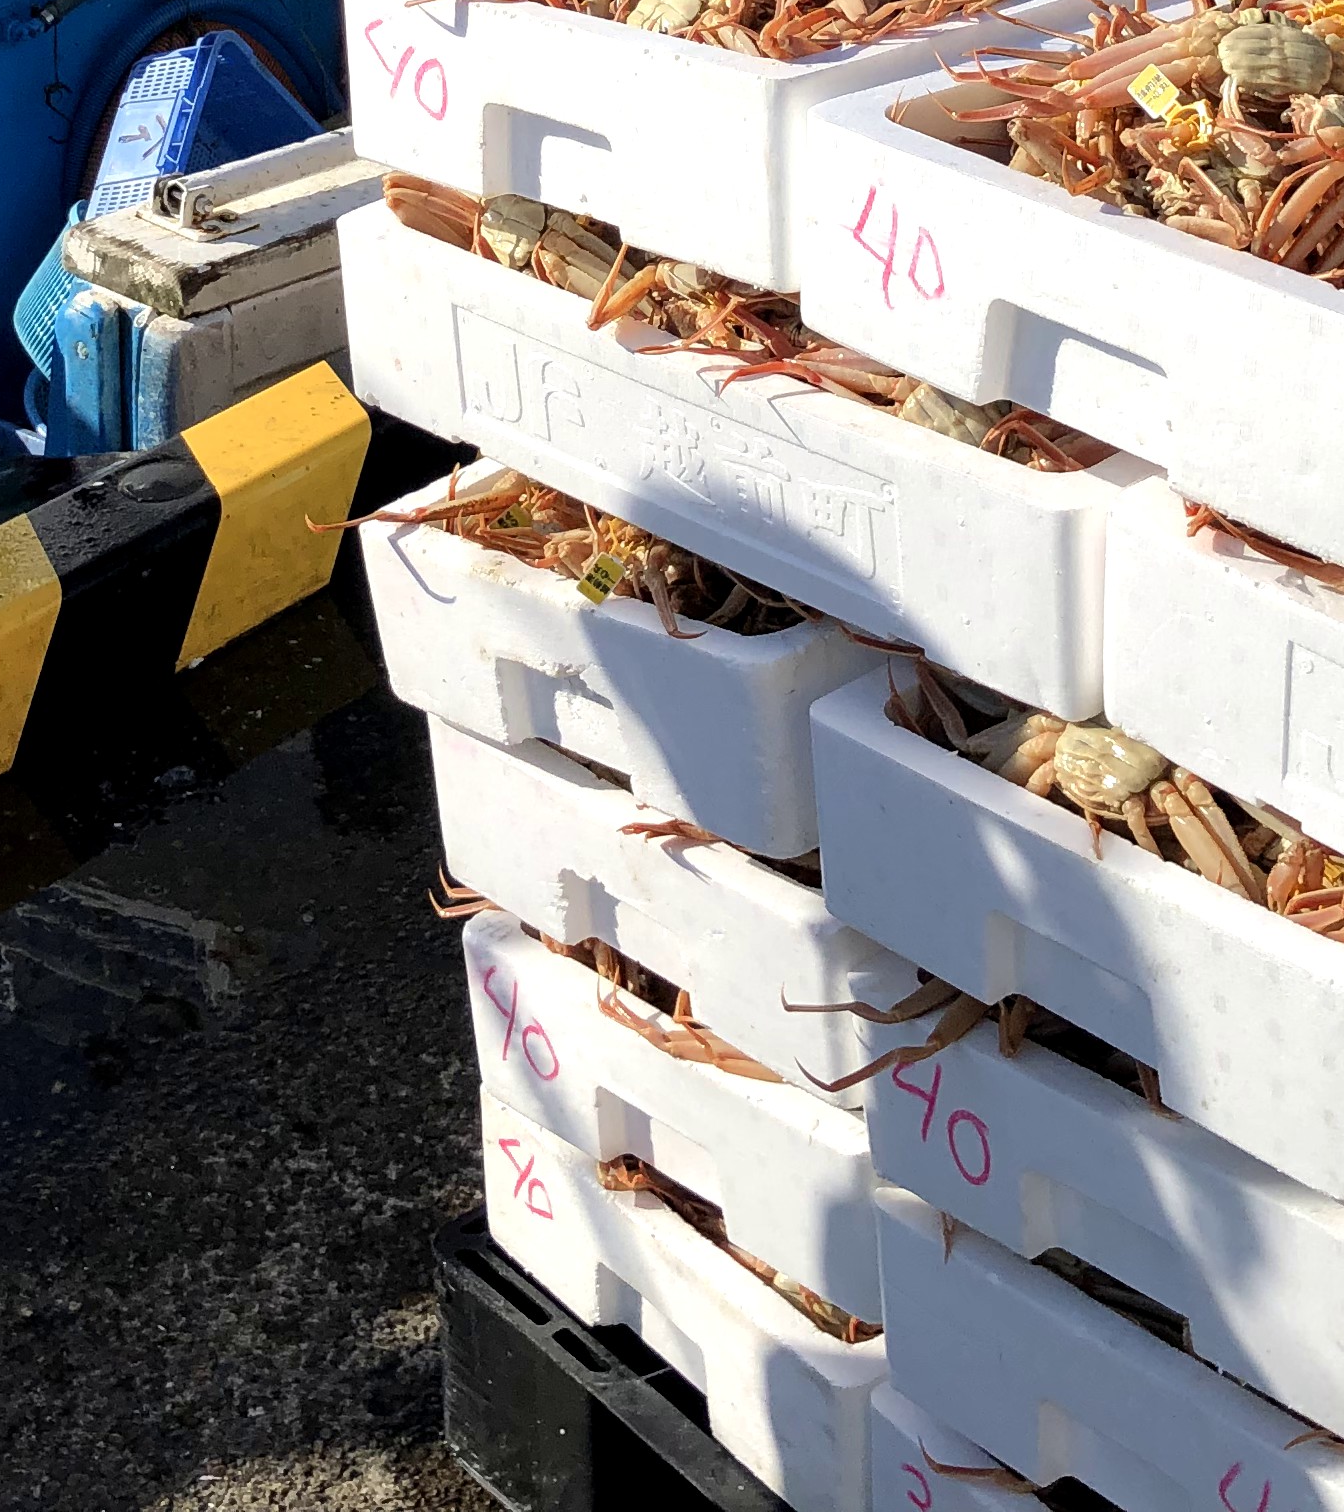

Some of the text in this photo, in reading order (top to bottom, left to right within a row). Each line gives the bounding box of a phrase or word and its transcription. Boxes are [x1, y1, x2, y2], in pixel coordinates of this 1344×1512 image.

[364, 19, 449, 122] 40
[852, 186, 947, 310] 40
[482, 963, 562, 1083] 40
[498, 1137, 554, 1220] 40
[892, 1060, 991, 1187] 40
